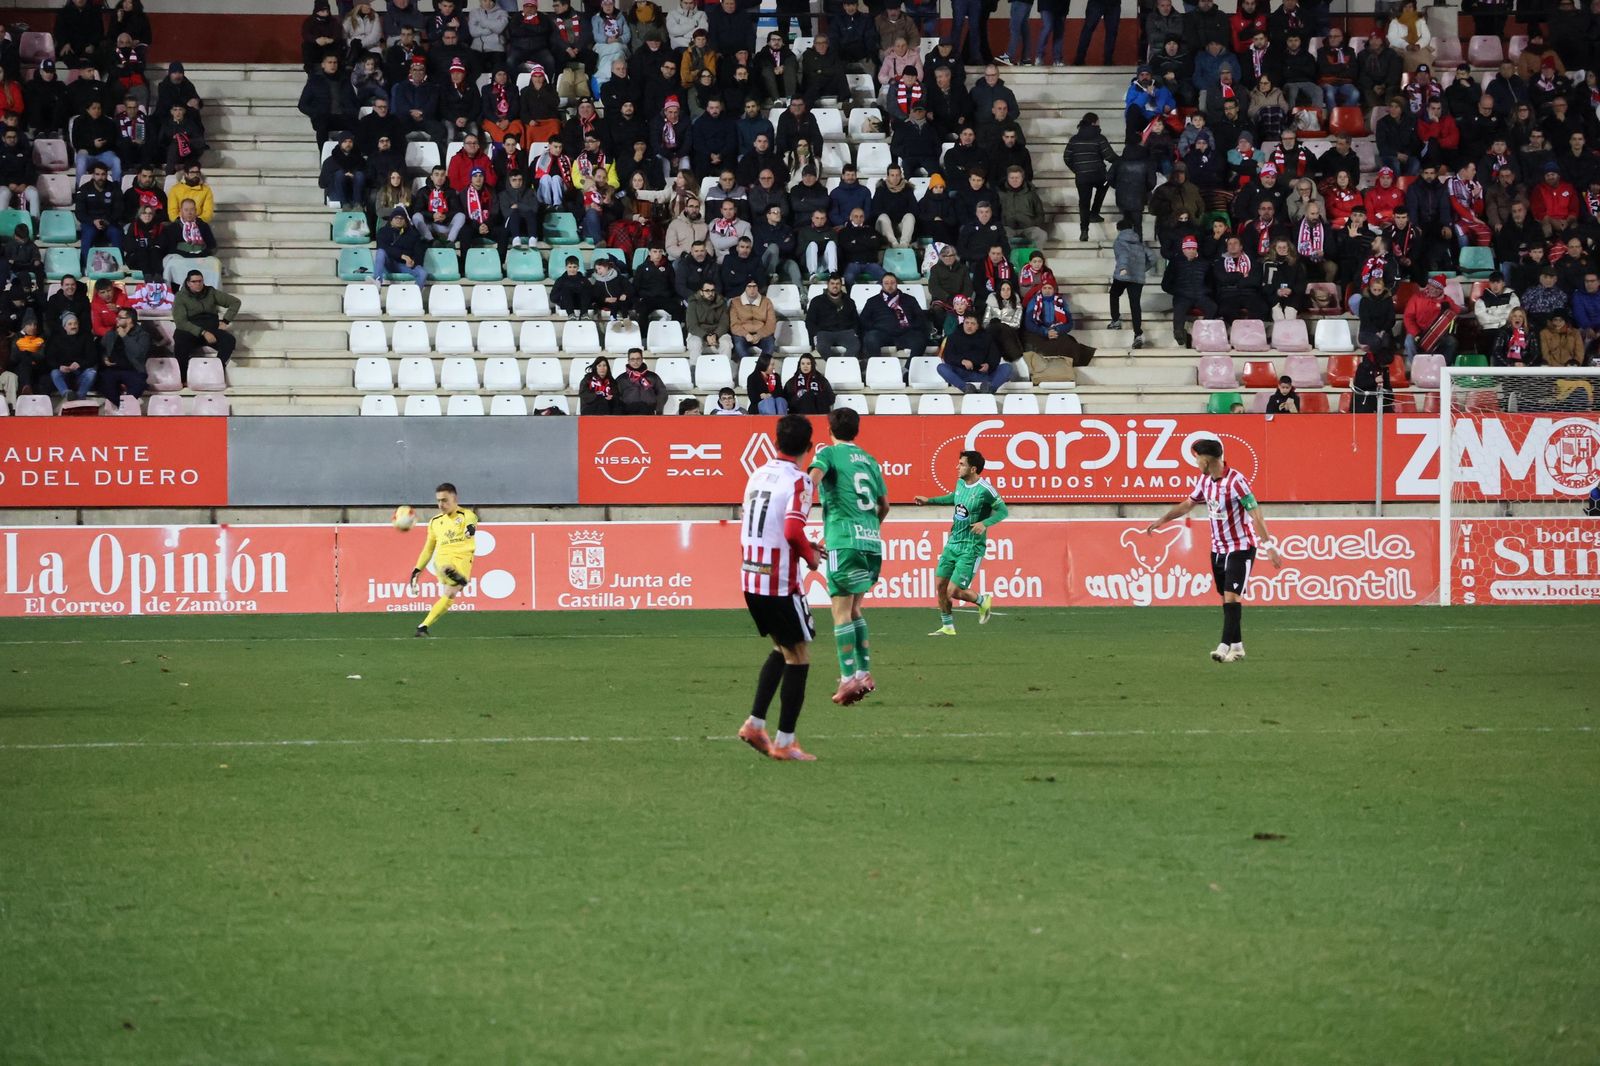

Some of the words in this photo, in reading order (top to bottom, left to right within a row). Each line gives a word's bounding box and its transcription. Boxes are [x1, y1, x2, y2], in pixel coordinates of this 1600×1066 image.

[4, 446, 149, 463] AURANTE
[594, 456, 651, 465] NISSAN
[667, 468, 724, 477] DACIA
[878, 460, 912, 476] tor
[21, 470, 80, 486] DEL
[94, 469, 199, 485] DUERO
[1103, 476, 1113, 488] Y
[1121, 476, 1198, 488] JAMON
[853, 471, 875, 511] 5
[747, 489, 772, 538] 11
[880, 531, 932, 561] arné
[1460, 523, 1477, 604] vinos
[4, 532, 68, 595] La
[88, 533, 289, 616] Opinión
[609, 573, 663, 588] Junta
[668, 572, 693, 588] de
[864, 567, 938, 599] astill
[979, 568, 1042, 598] León
[1243, 567, 1417, 601] nfantil
[25, 597, 46, 613] El
[51, 597, 125, 614] Correo
[145, 596, 171, 613] de
[175, 596, 258, 612] Zamora
[386, 601, 432, 612] castilla
[447, 601, 475, 612] eón
[557, 592, 625, 608] Castilla
[628, 595, 641, 610] y
[646, 591, 693, 607] León
